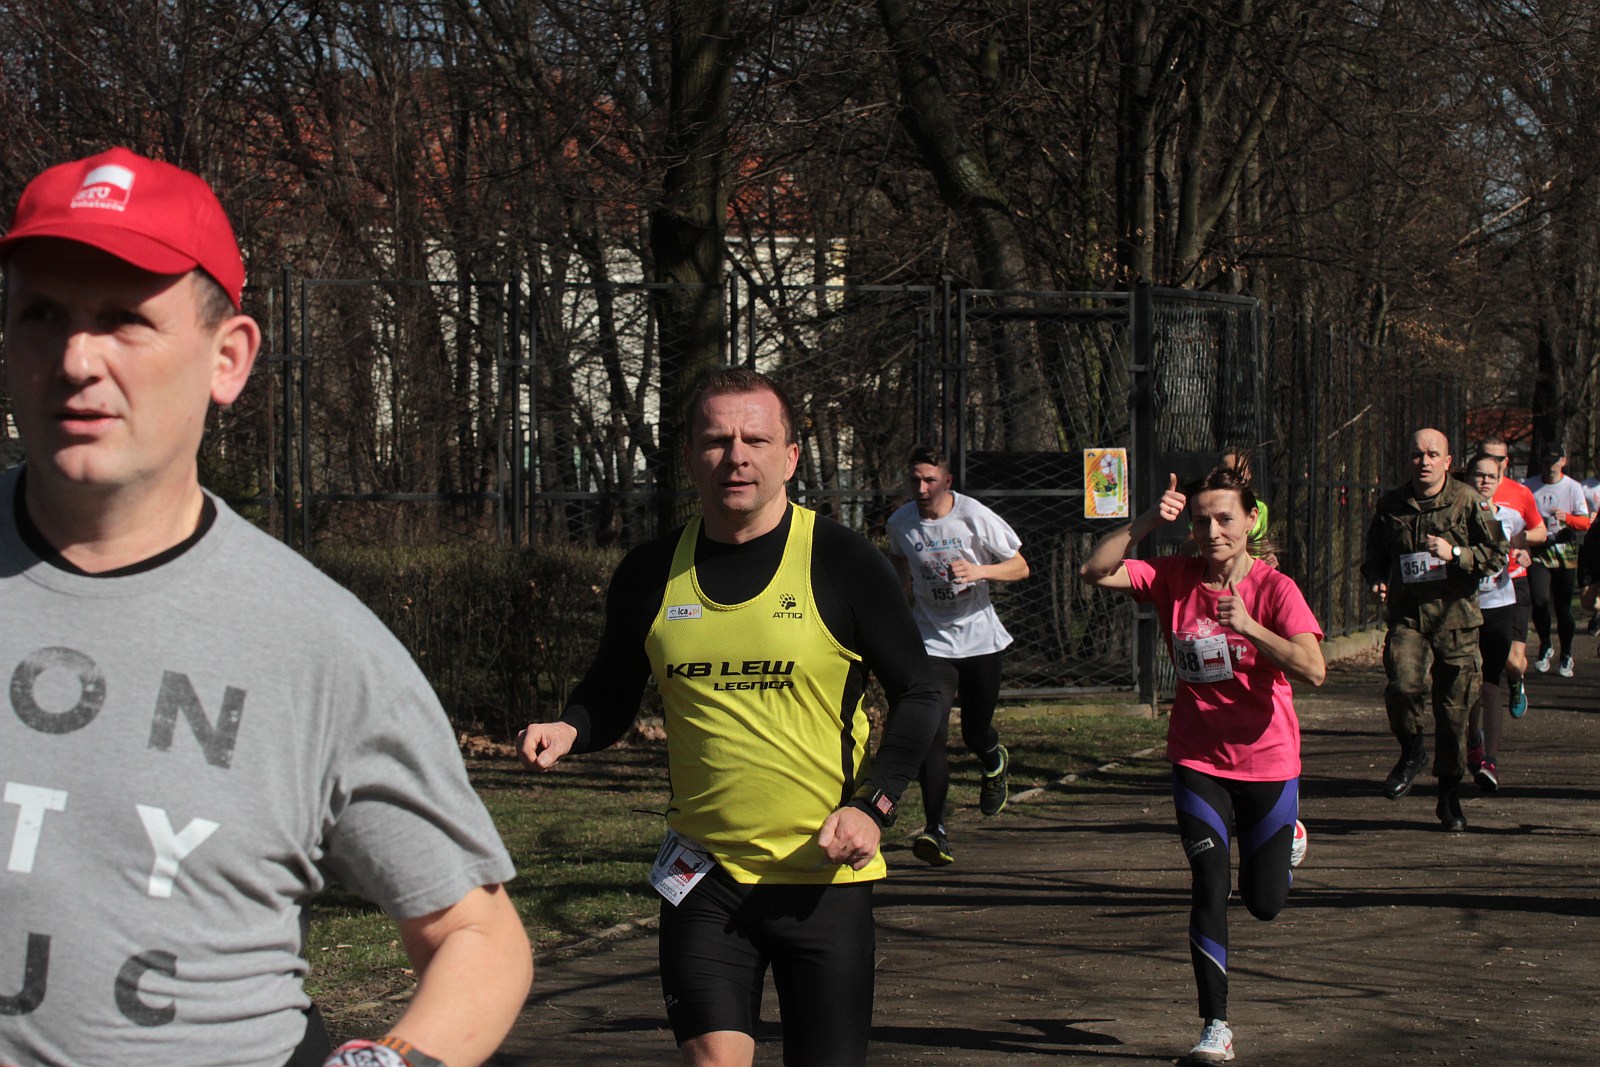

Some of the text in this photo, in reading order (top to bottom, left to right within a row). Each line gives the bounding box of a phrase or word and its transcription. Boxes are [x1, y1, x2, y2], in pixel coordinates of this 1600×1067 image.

[1403, 561, 1428, 576] 354
[931, 588, 955, 600] 155
[772, 611, 803, 619] ATTIQ
[666, 660, 796, 680] KB LEW
[713, 680, 794, 692] LEGNICA
